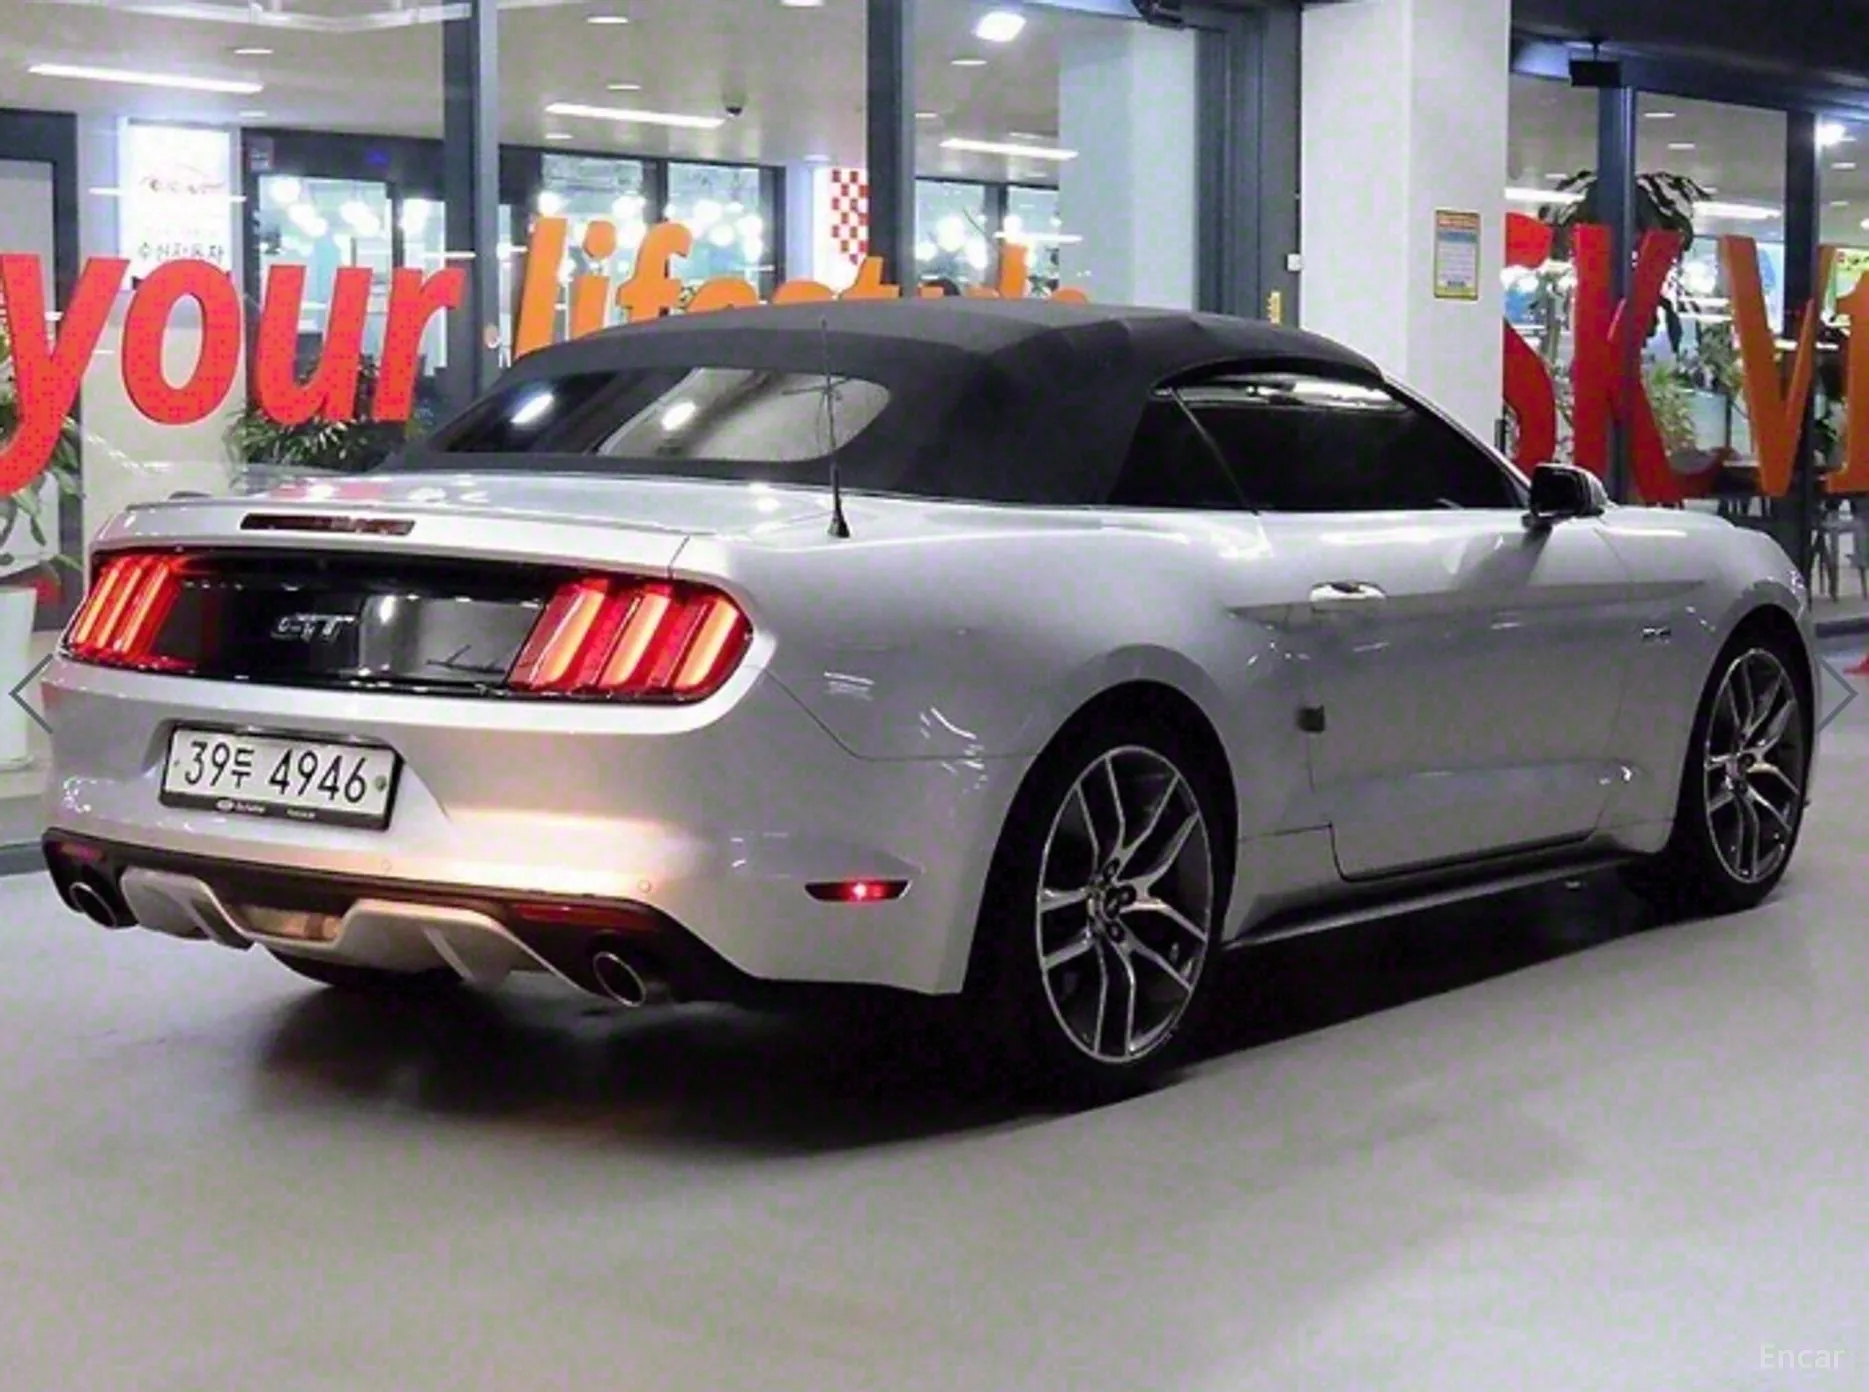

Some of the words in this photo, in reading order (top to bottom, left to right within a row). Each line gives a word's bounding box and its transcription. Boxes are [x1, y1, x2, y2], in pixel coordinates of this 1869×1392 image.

[0, 254, 467, 498] your
[271, 613, 356, 641] GT
[184, 740, 255, 788] 39두
[268, 747, 368, 803] 4946
